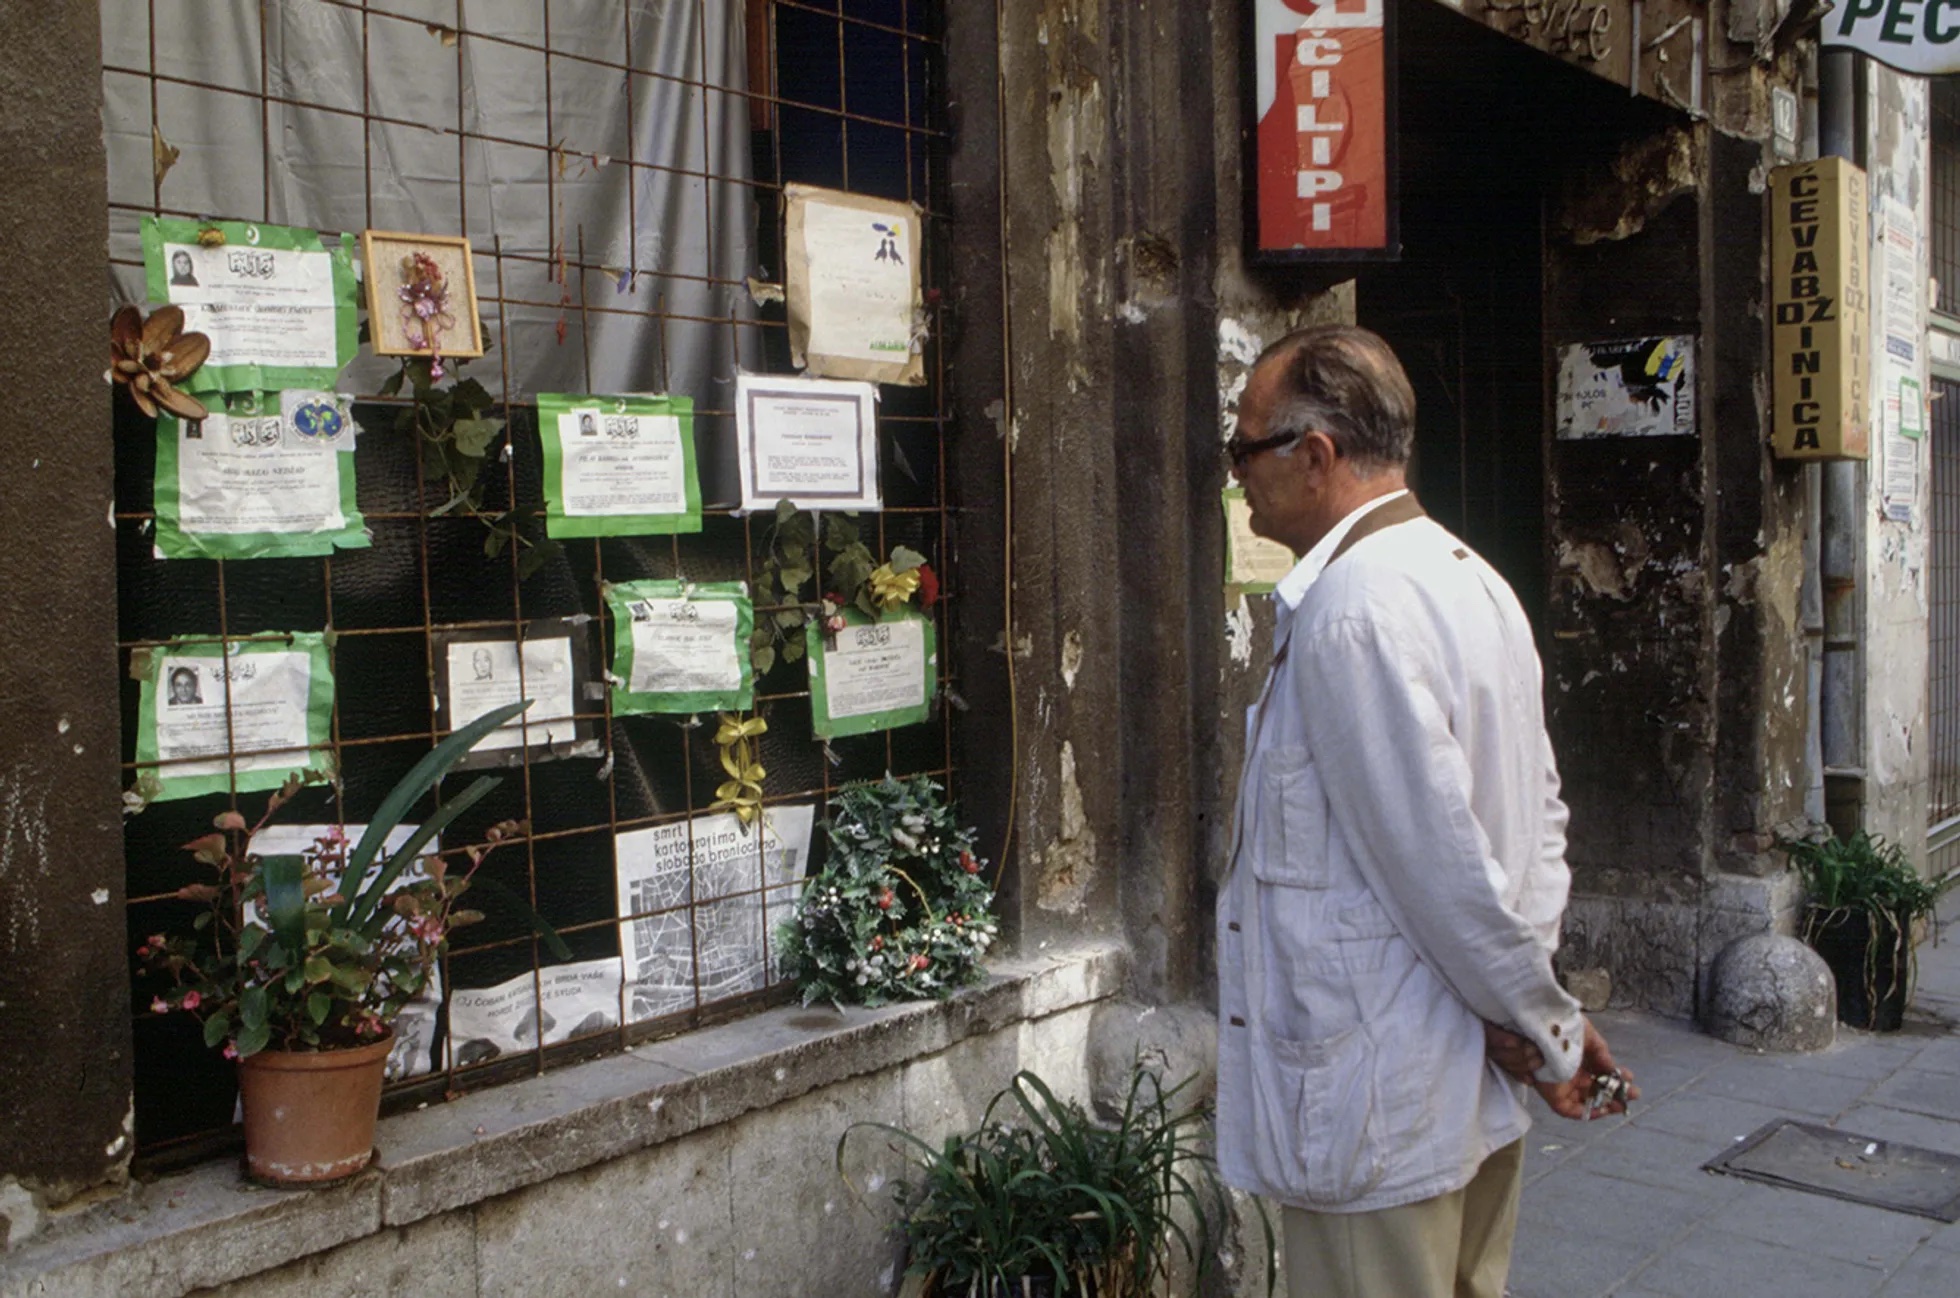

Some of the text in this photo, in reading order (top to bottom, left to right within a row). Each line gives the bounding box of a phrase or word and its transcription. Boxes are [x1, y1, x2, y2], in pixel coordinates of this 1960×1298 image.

[1297, 30, 1344, 231] ČILIPI
[1776, 165, 1836, 451] ĆEVABDŽINICA
[653, 825, 683, 841] smrt
